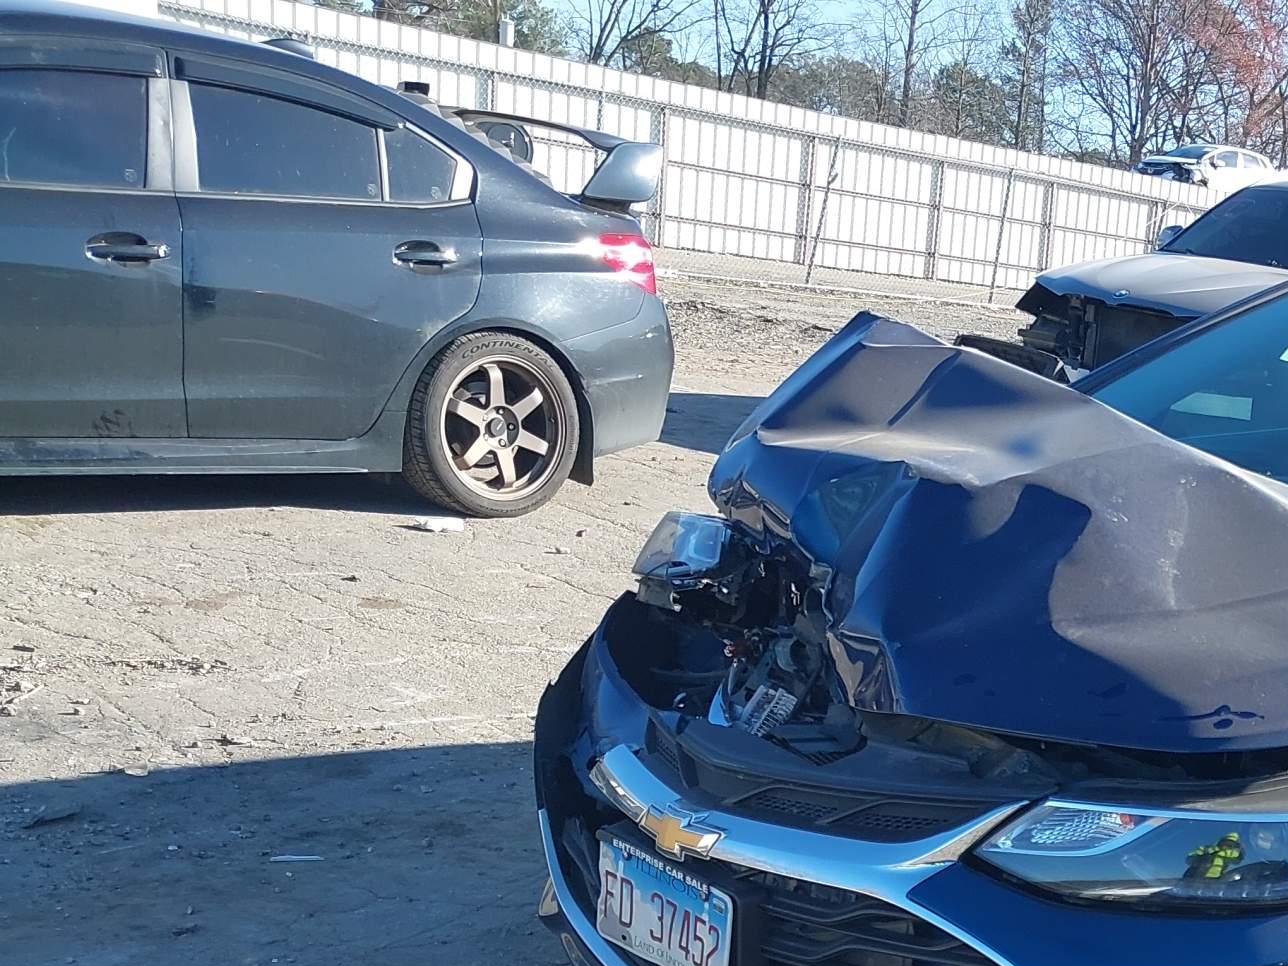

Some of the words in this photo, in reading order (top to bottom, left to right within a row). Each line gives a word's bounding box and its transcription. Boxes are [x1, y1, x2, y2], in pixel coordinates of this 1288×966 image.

[462, 340, 555, 371] CONTINENTAL
[613, 839, 664, 871] ENTERPRISE
[665, 866, 684, 881] CAR
[604, 869, 633, 929] FD
